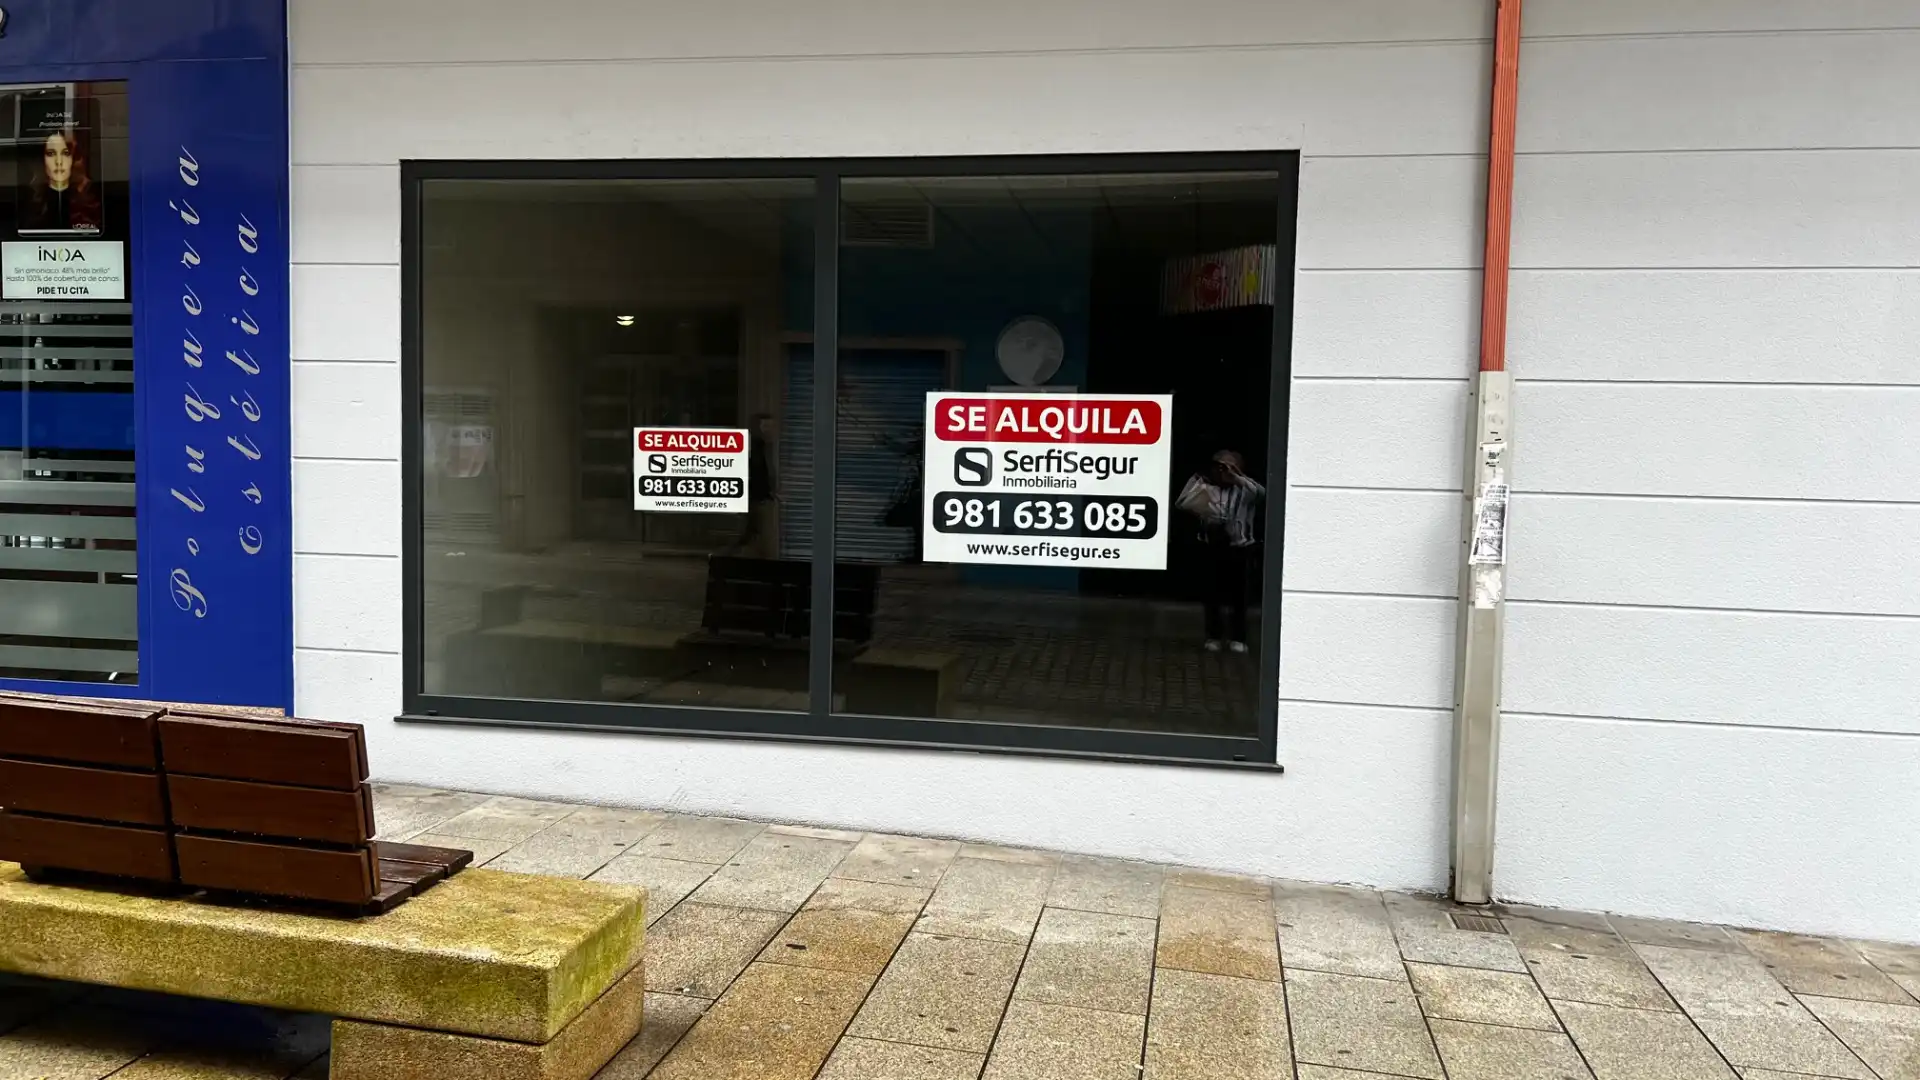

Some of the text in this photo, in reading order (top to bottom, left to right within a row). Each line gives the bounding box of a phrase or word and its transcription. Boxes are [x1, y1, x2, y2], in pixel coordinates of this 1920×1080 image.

[37, 286, 89, 295] PIDE TU CITA
[946, 405, 1148, 439] SE ALQUILA
[644, 433, 738, 450] SE ALQUILA
[671, 455, 735, 470] SerfiSegur
[671, 467, 707, 475] Inmobiliaria
[1003, 449, 1138, 480] SerfiSegur
[643, 478, 739, 495] 981 633 085
[1002, 475, 1077, 489] Inmobiliaria
[655, 499, 727, 509] www.serfisegur.es
[944, 498, 1147, 533] 981 633 085
[967, 542, 1121, 561] www.serfisegur.es
